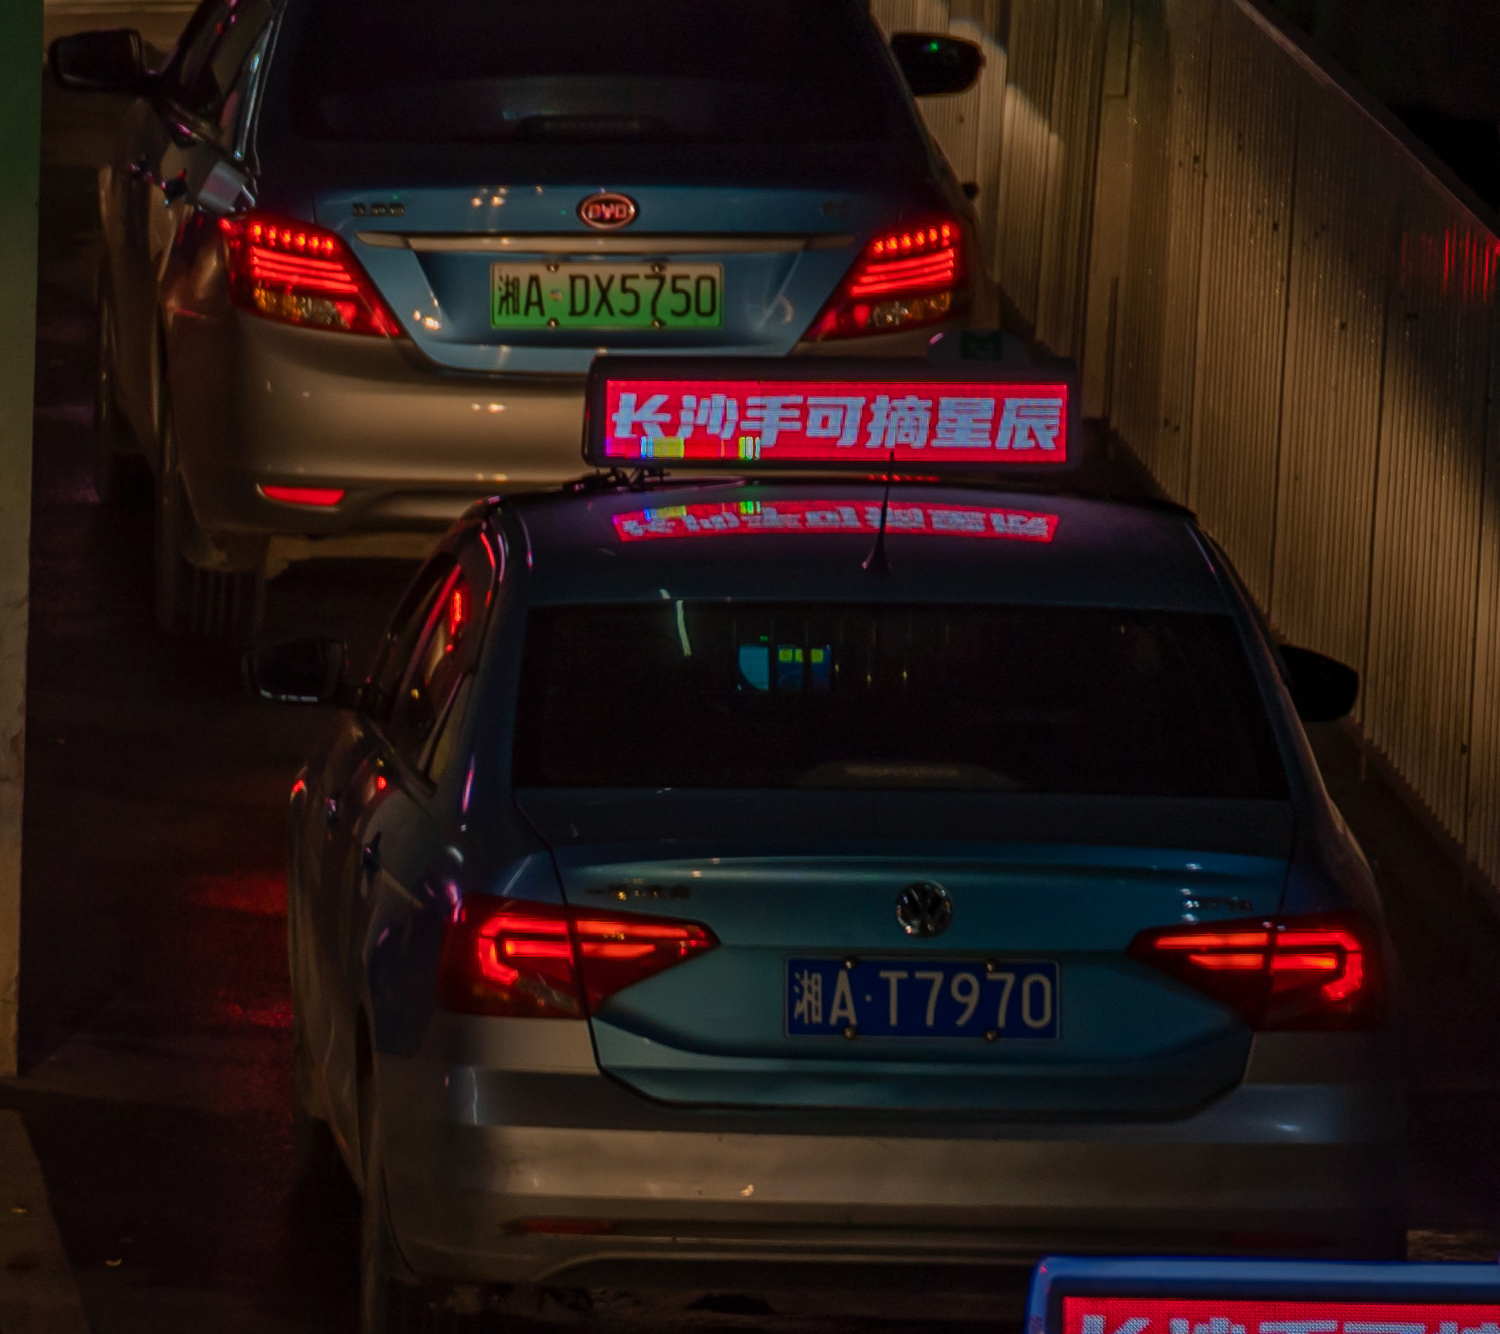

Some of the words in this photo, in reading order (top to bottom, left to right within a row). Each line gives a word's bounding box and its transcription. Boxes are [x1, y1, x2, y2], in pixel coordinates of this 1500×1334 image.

[612, 393, 1061, 450] 长沙手可摘星辰
